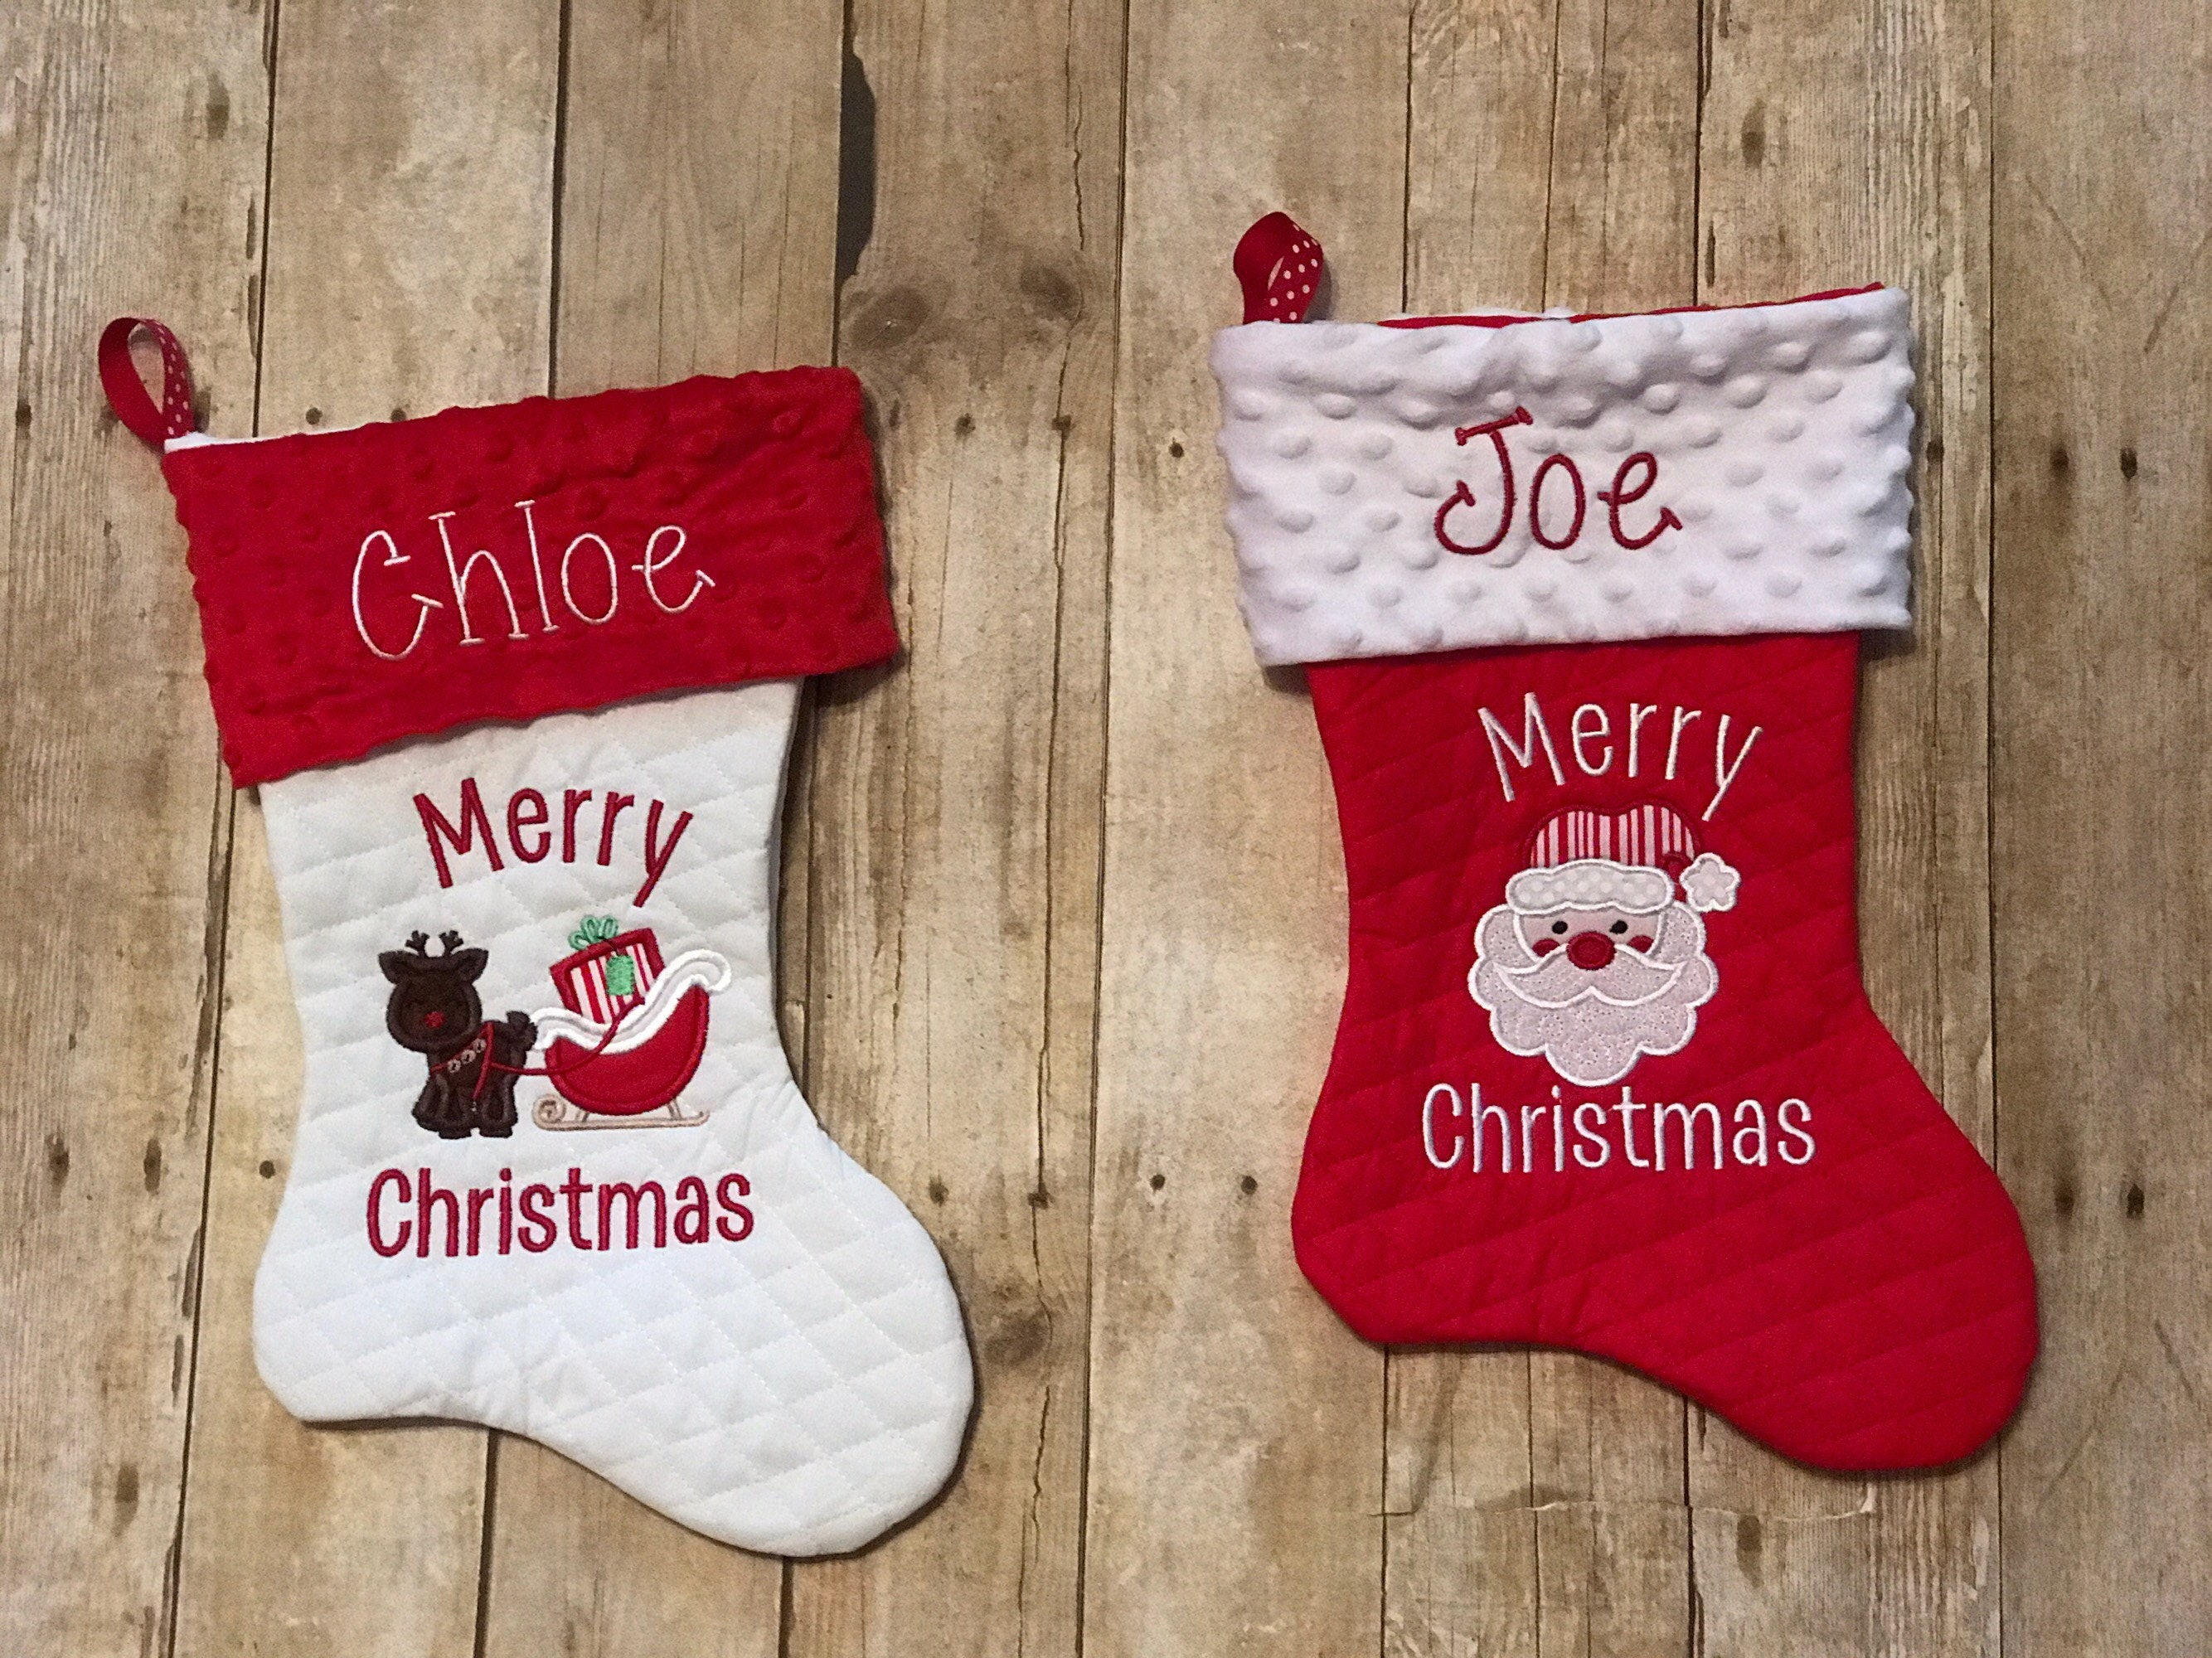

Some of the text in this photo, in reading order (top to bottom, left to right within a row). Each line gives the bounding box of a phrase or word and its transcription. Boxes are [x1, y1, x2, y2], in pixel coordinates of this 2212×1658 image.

[1433, 406, 1682, 555] Joe
[352, 499, 716, 661] Chloe
[1477, 692, 1763, 822] Merry
[413, 778, 694, 908] Merry
[1422, 1083, 1816, 1173] Christmas
[366, 1168, 754, 1258] Christmas
